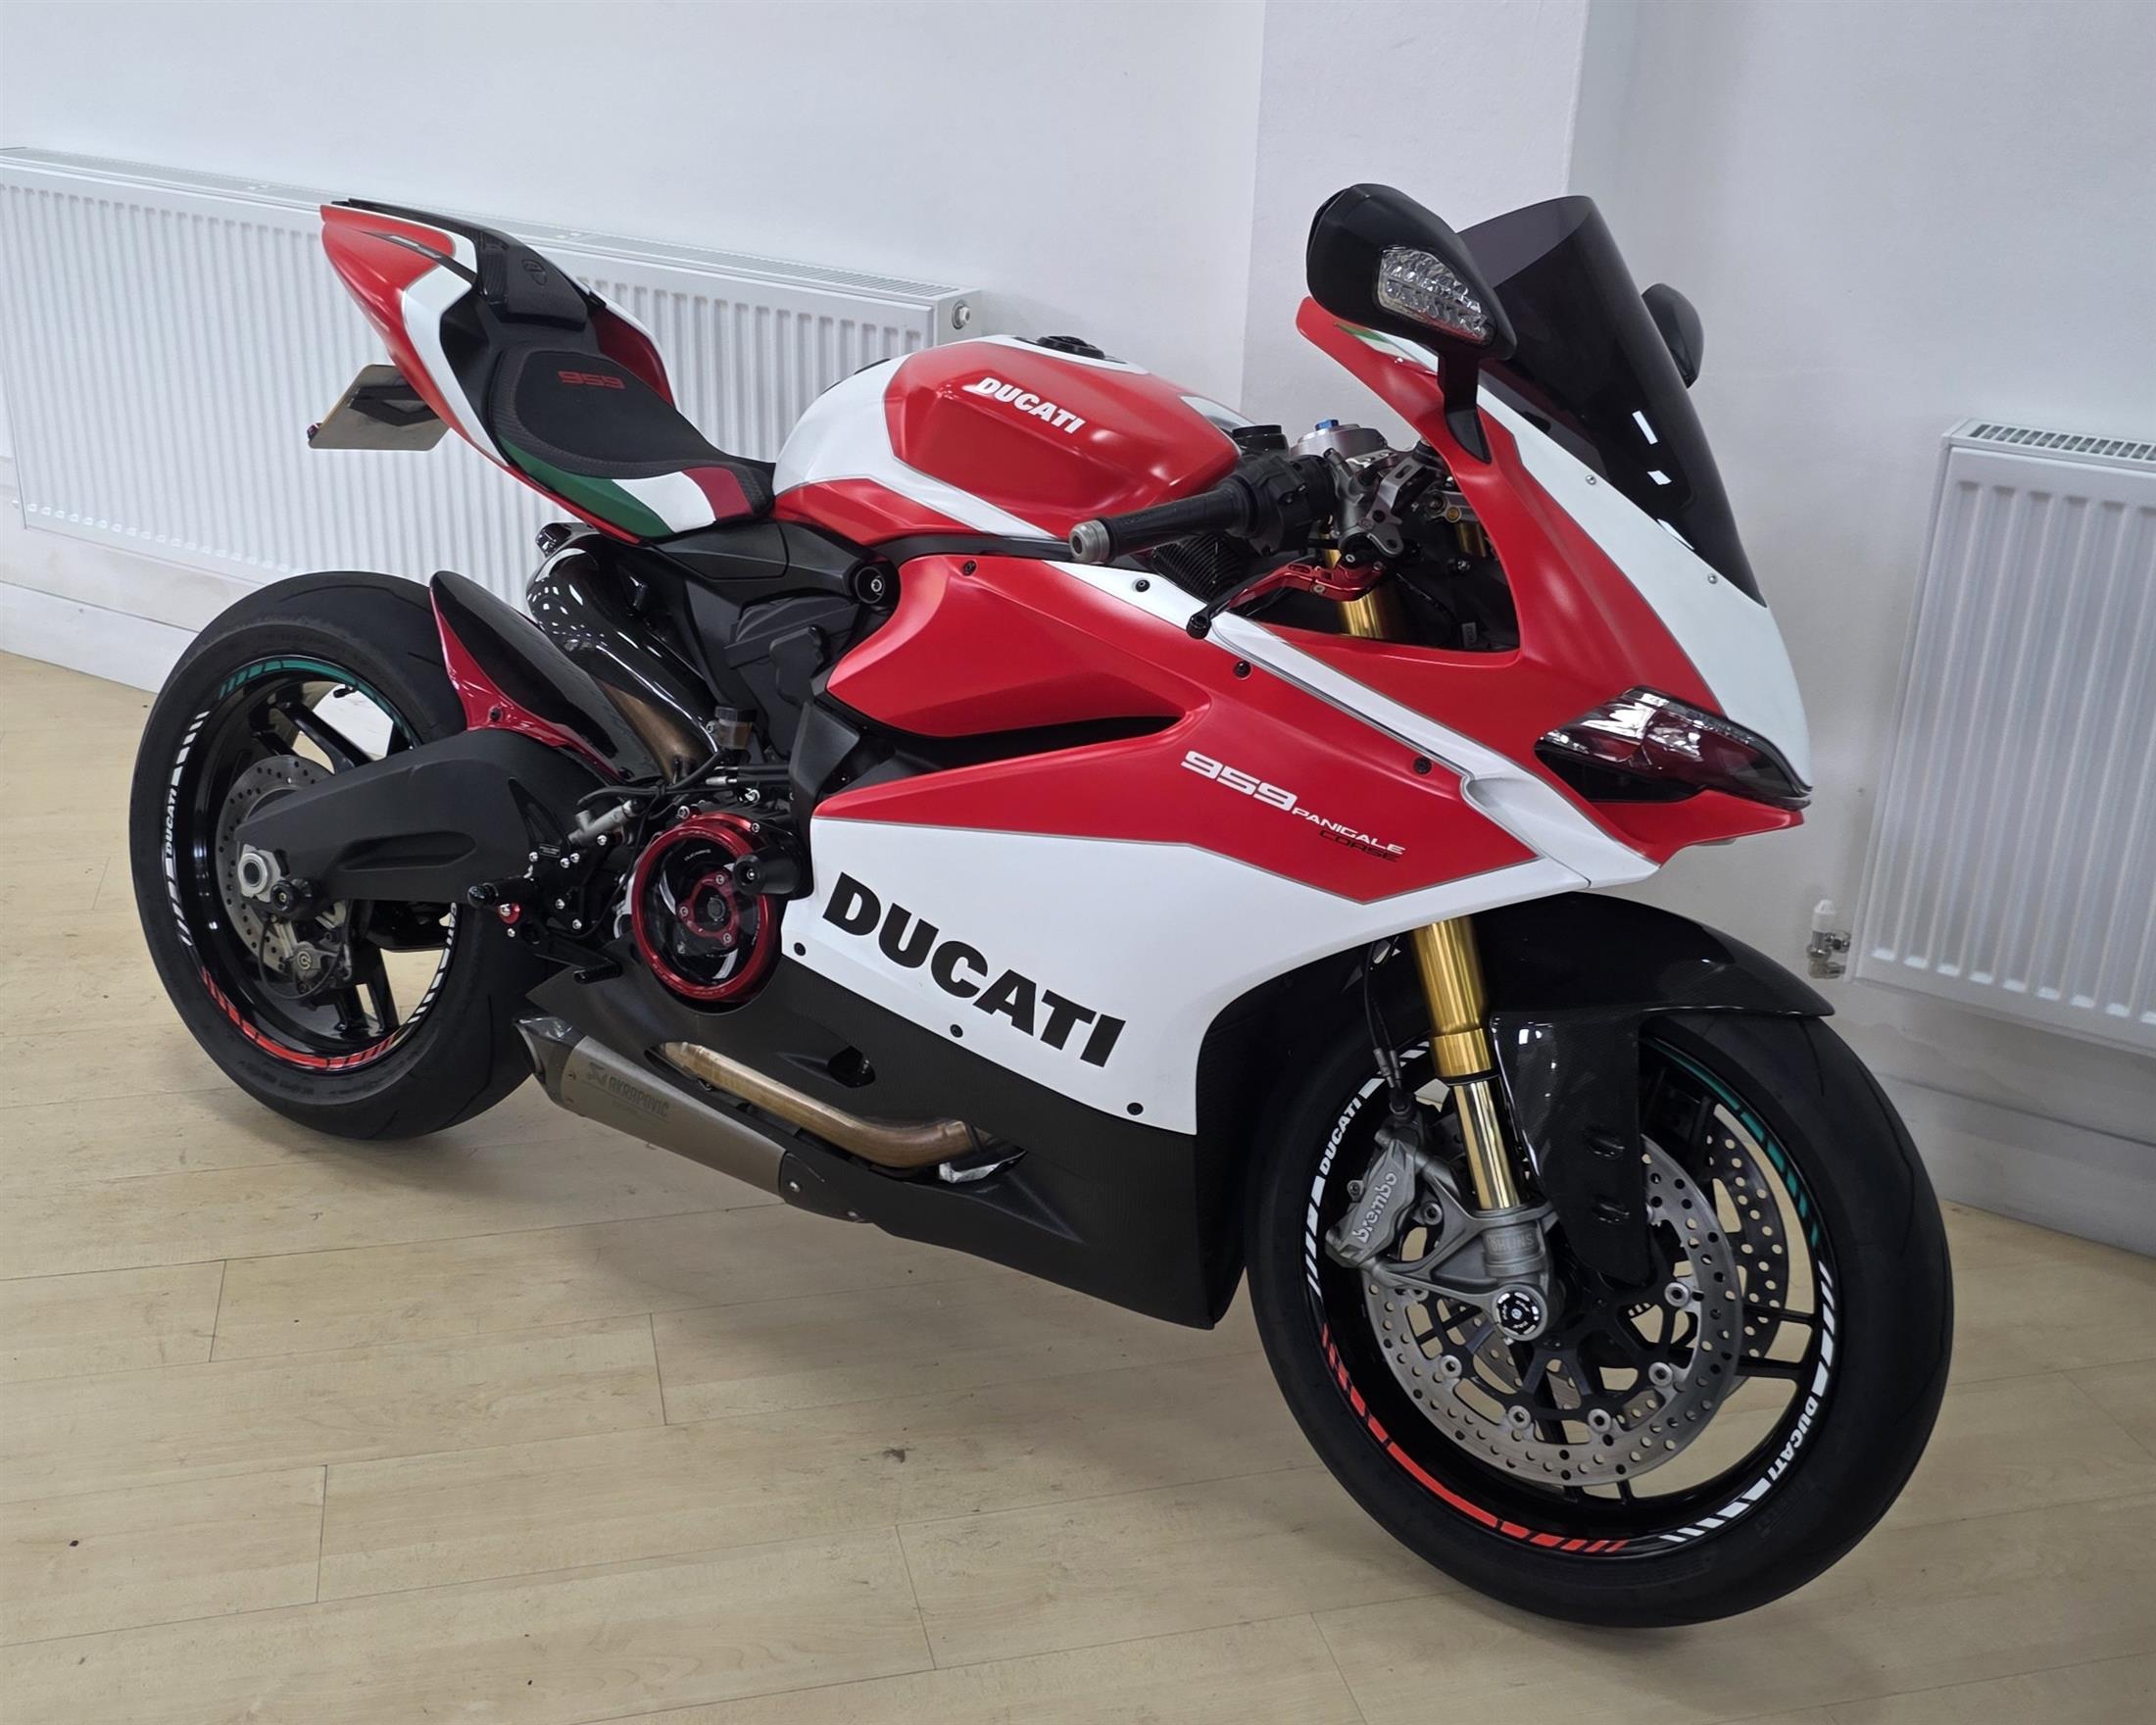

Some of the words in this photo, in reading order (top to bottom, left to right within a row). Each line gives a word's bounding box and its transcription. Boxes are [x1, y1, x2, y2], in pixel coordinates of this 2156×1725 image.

[558, 370, 625, 389] 959
[973, 376, 1086, 434] DUCATI
[165, 787, 177, 856] DUCATI
[1181, 750, 1298, 812] 959
[1292, 807, 1405, 856] PANIGALE
[1319, 829, 1404, 863] CORSE
[446, 902, 458, 946] CATI
[822, 871, 1126, 1068] DUCATI
[1319, 1097, 1362, 1176] DUCATI
[1352, 1172, 1397, 1243] brembo
[1767, 1396, 1819, 1481] DUCATI
